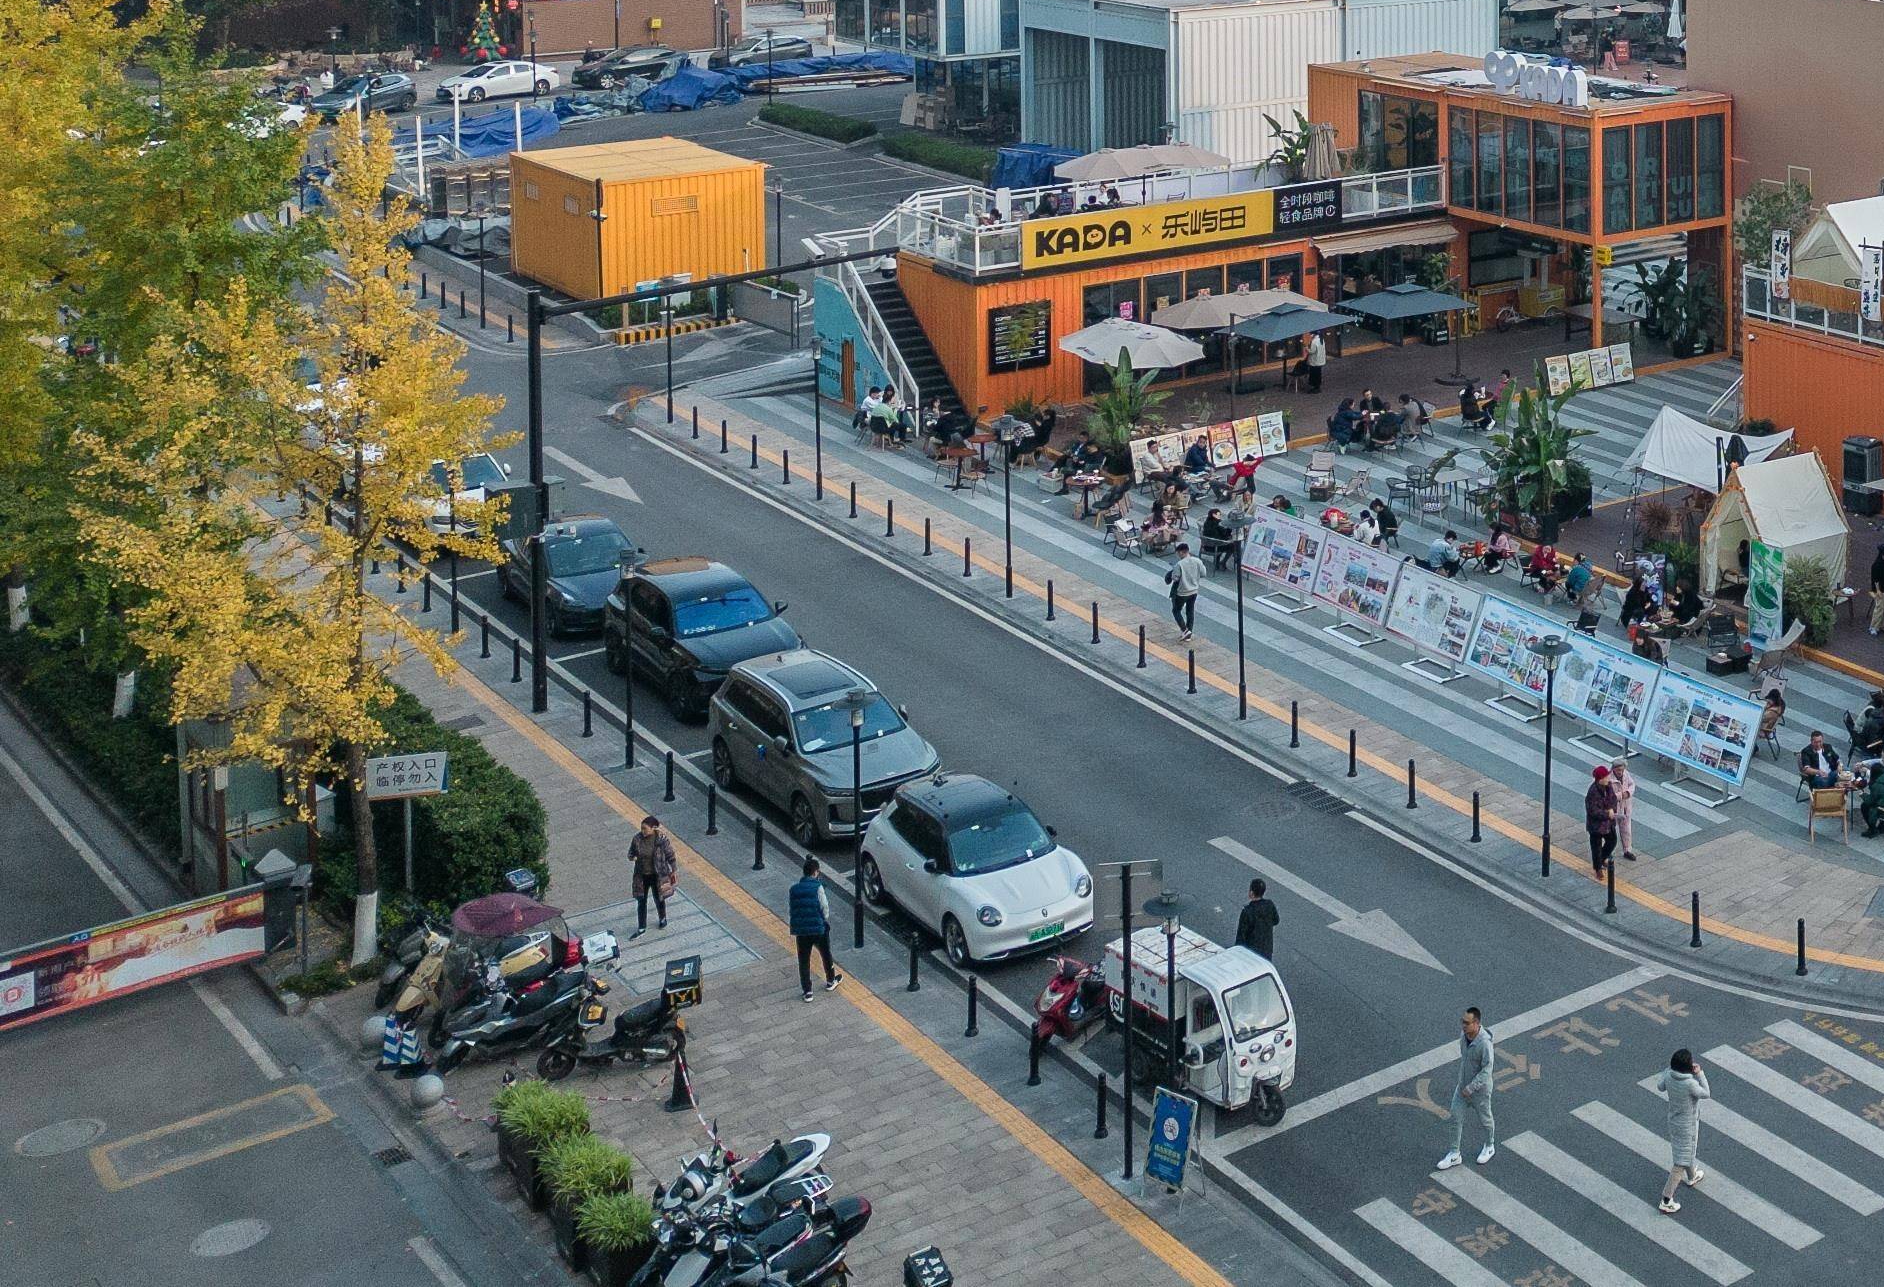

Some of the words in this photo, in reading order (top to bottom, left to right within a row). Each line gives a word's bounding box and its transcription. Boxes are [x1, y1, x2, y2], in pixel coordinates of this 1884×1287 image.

[1279, 188, 1336, 209] 全时段咖啡
[1035, 220, 1132, 258] KADA
[1161, 205, 1247, 240] 乐屿田
[376, 759, 437, 775] 产权入口
[376, 771, 438, 788] 临停勿入
